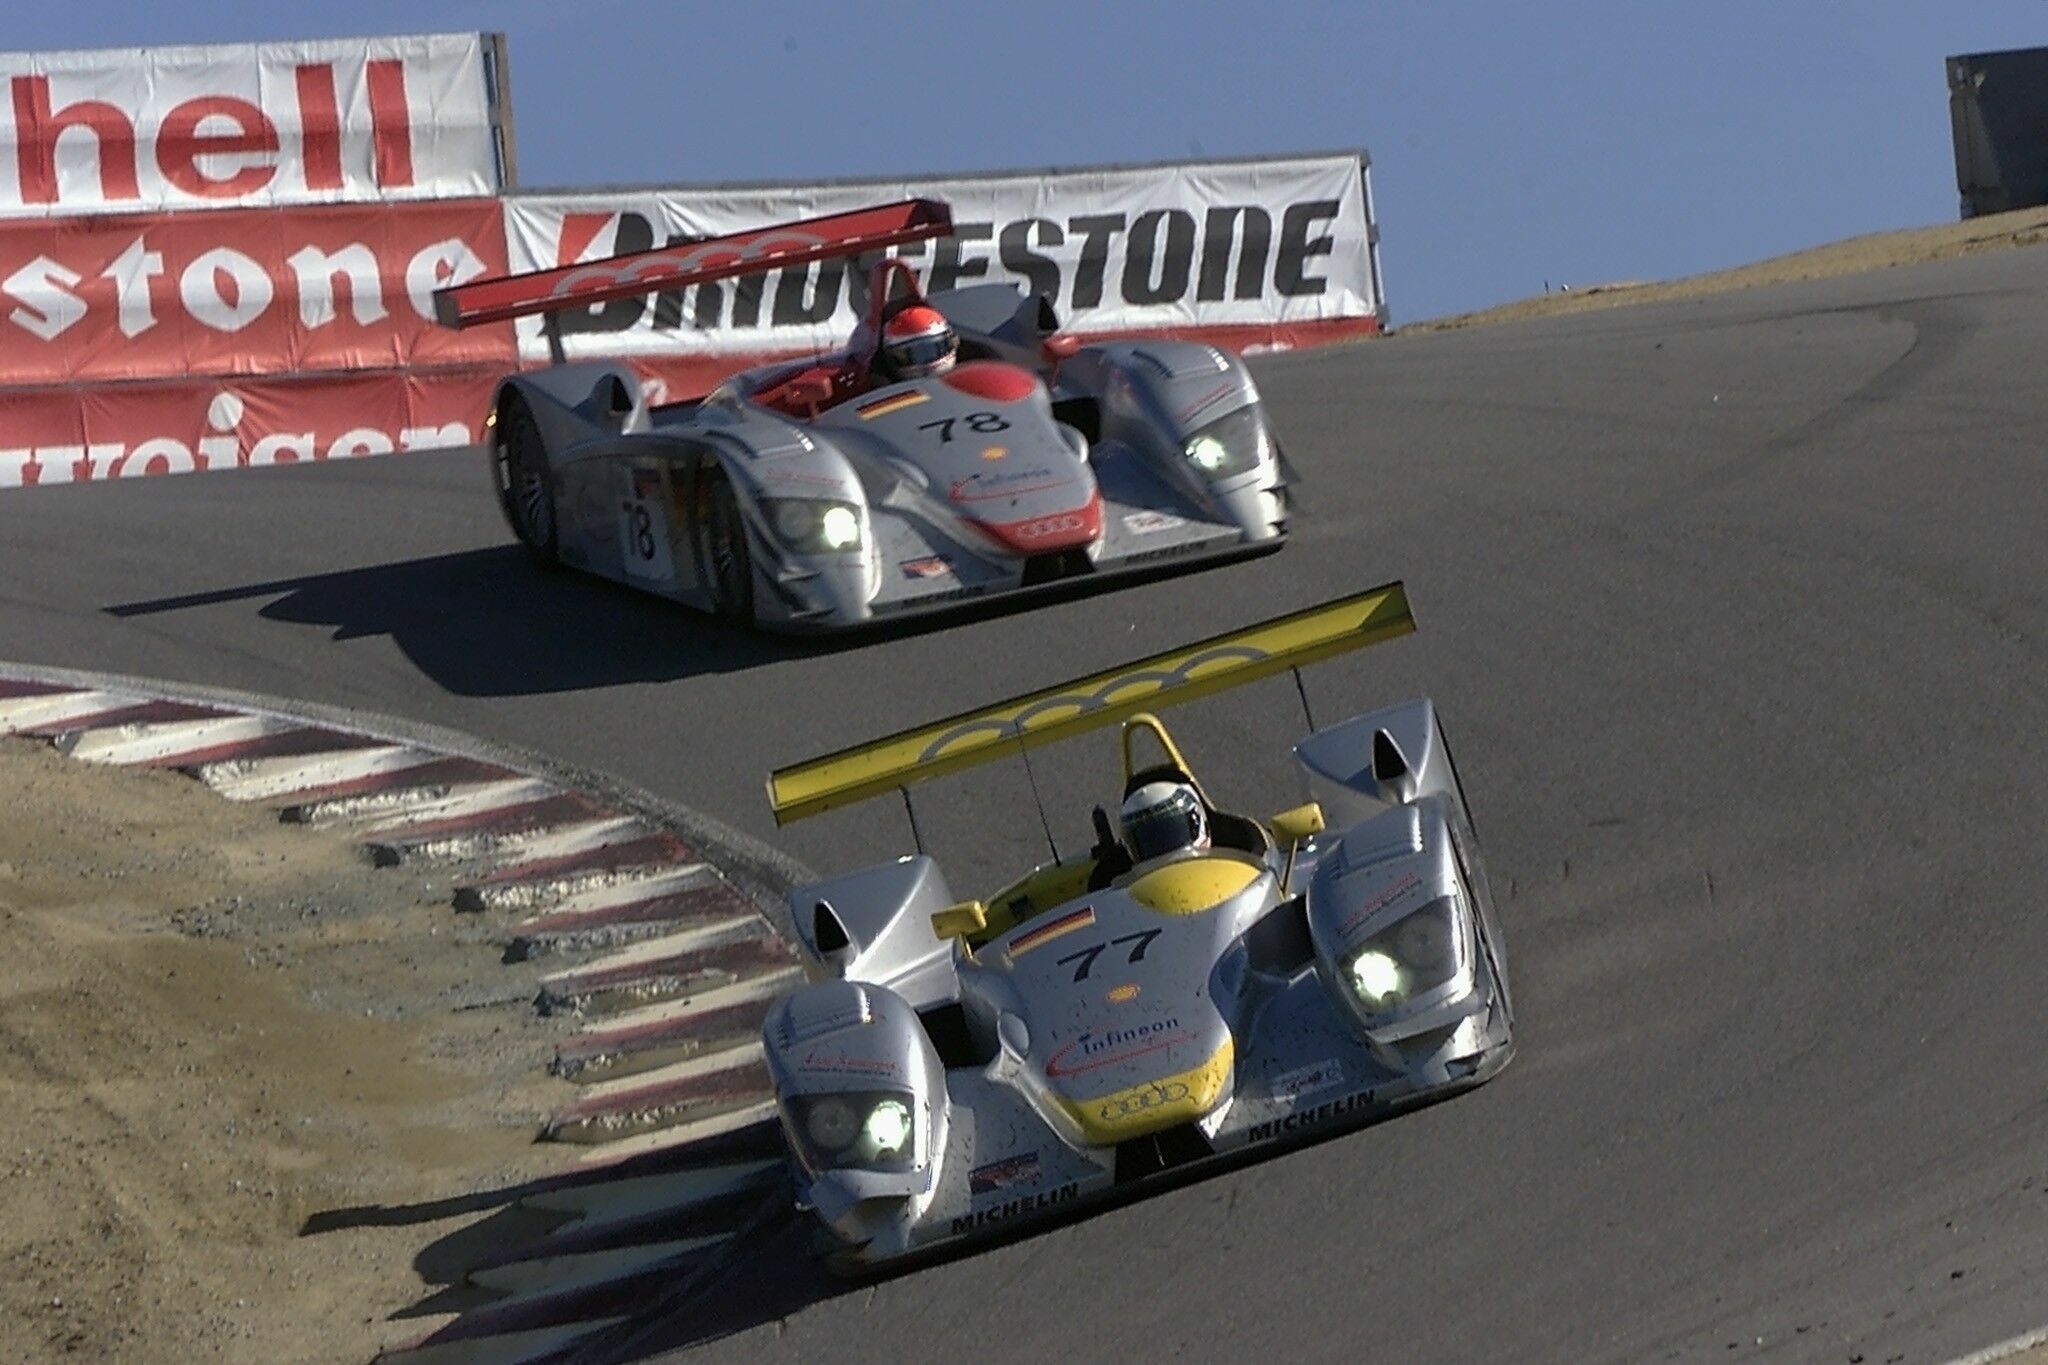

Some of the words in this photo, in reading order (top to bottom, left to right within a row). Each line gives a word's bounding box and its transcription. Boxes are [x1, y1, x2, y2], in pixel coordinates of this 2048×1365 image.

[2, 235, 488, 340] stone
[917, 411, 1011, 445] 78
[1056, 927, 1163, 984] 77
[1079, 1018, 1180, 1055] Infineon
[1247, 1089, 1376, 1143] MICHELIN
[951, 1181, 1080, 1235] MICHELIN
